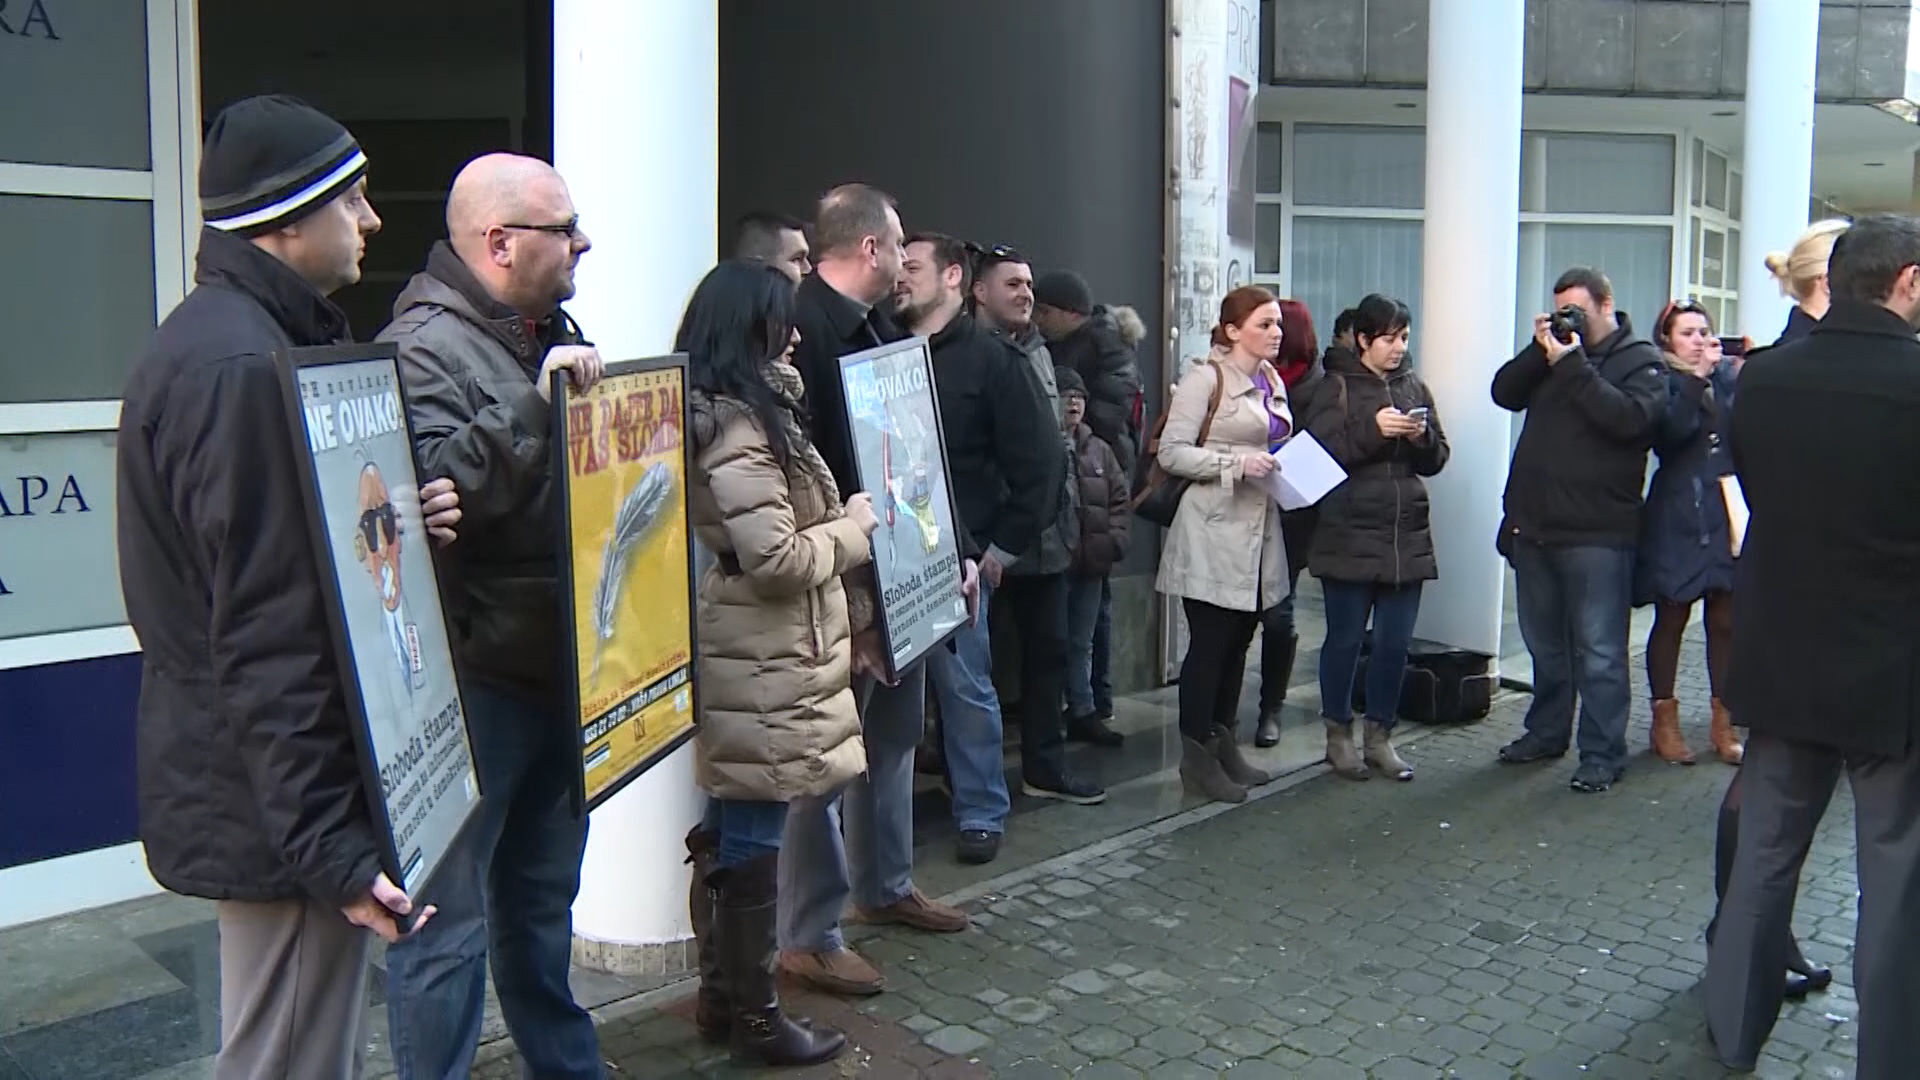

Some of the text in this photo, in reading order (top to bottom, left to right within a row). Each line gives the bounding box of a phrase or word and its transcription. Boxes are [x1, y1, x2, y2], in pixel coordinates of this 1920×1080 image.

[600, 372, 679, 393] novinari
[876, 366, 928, 402] OVAKO!
[305, 391, 403, 453] NE OVAKO!
[884, 552, 957, 608] Sloboda štampe
[380, 735, 424, 799] Sloboda
[423, 696, 461, 749] štampe
